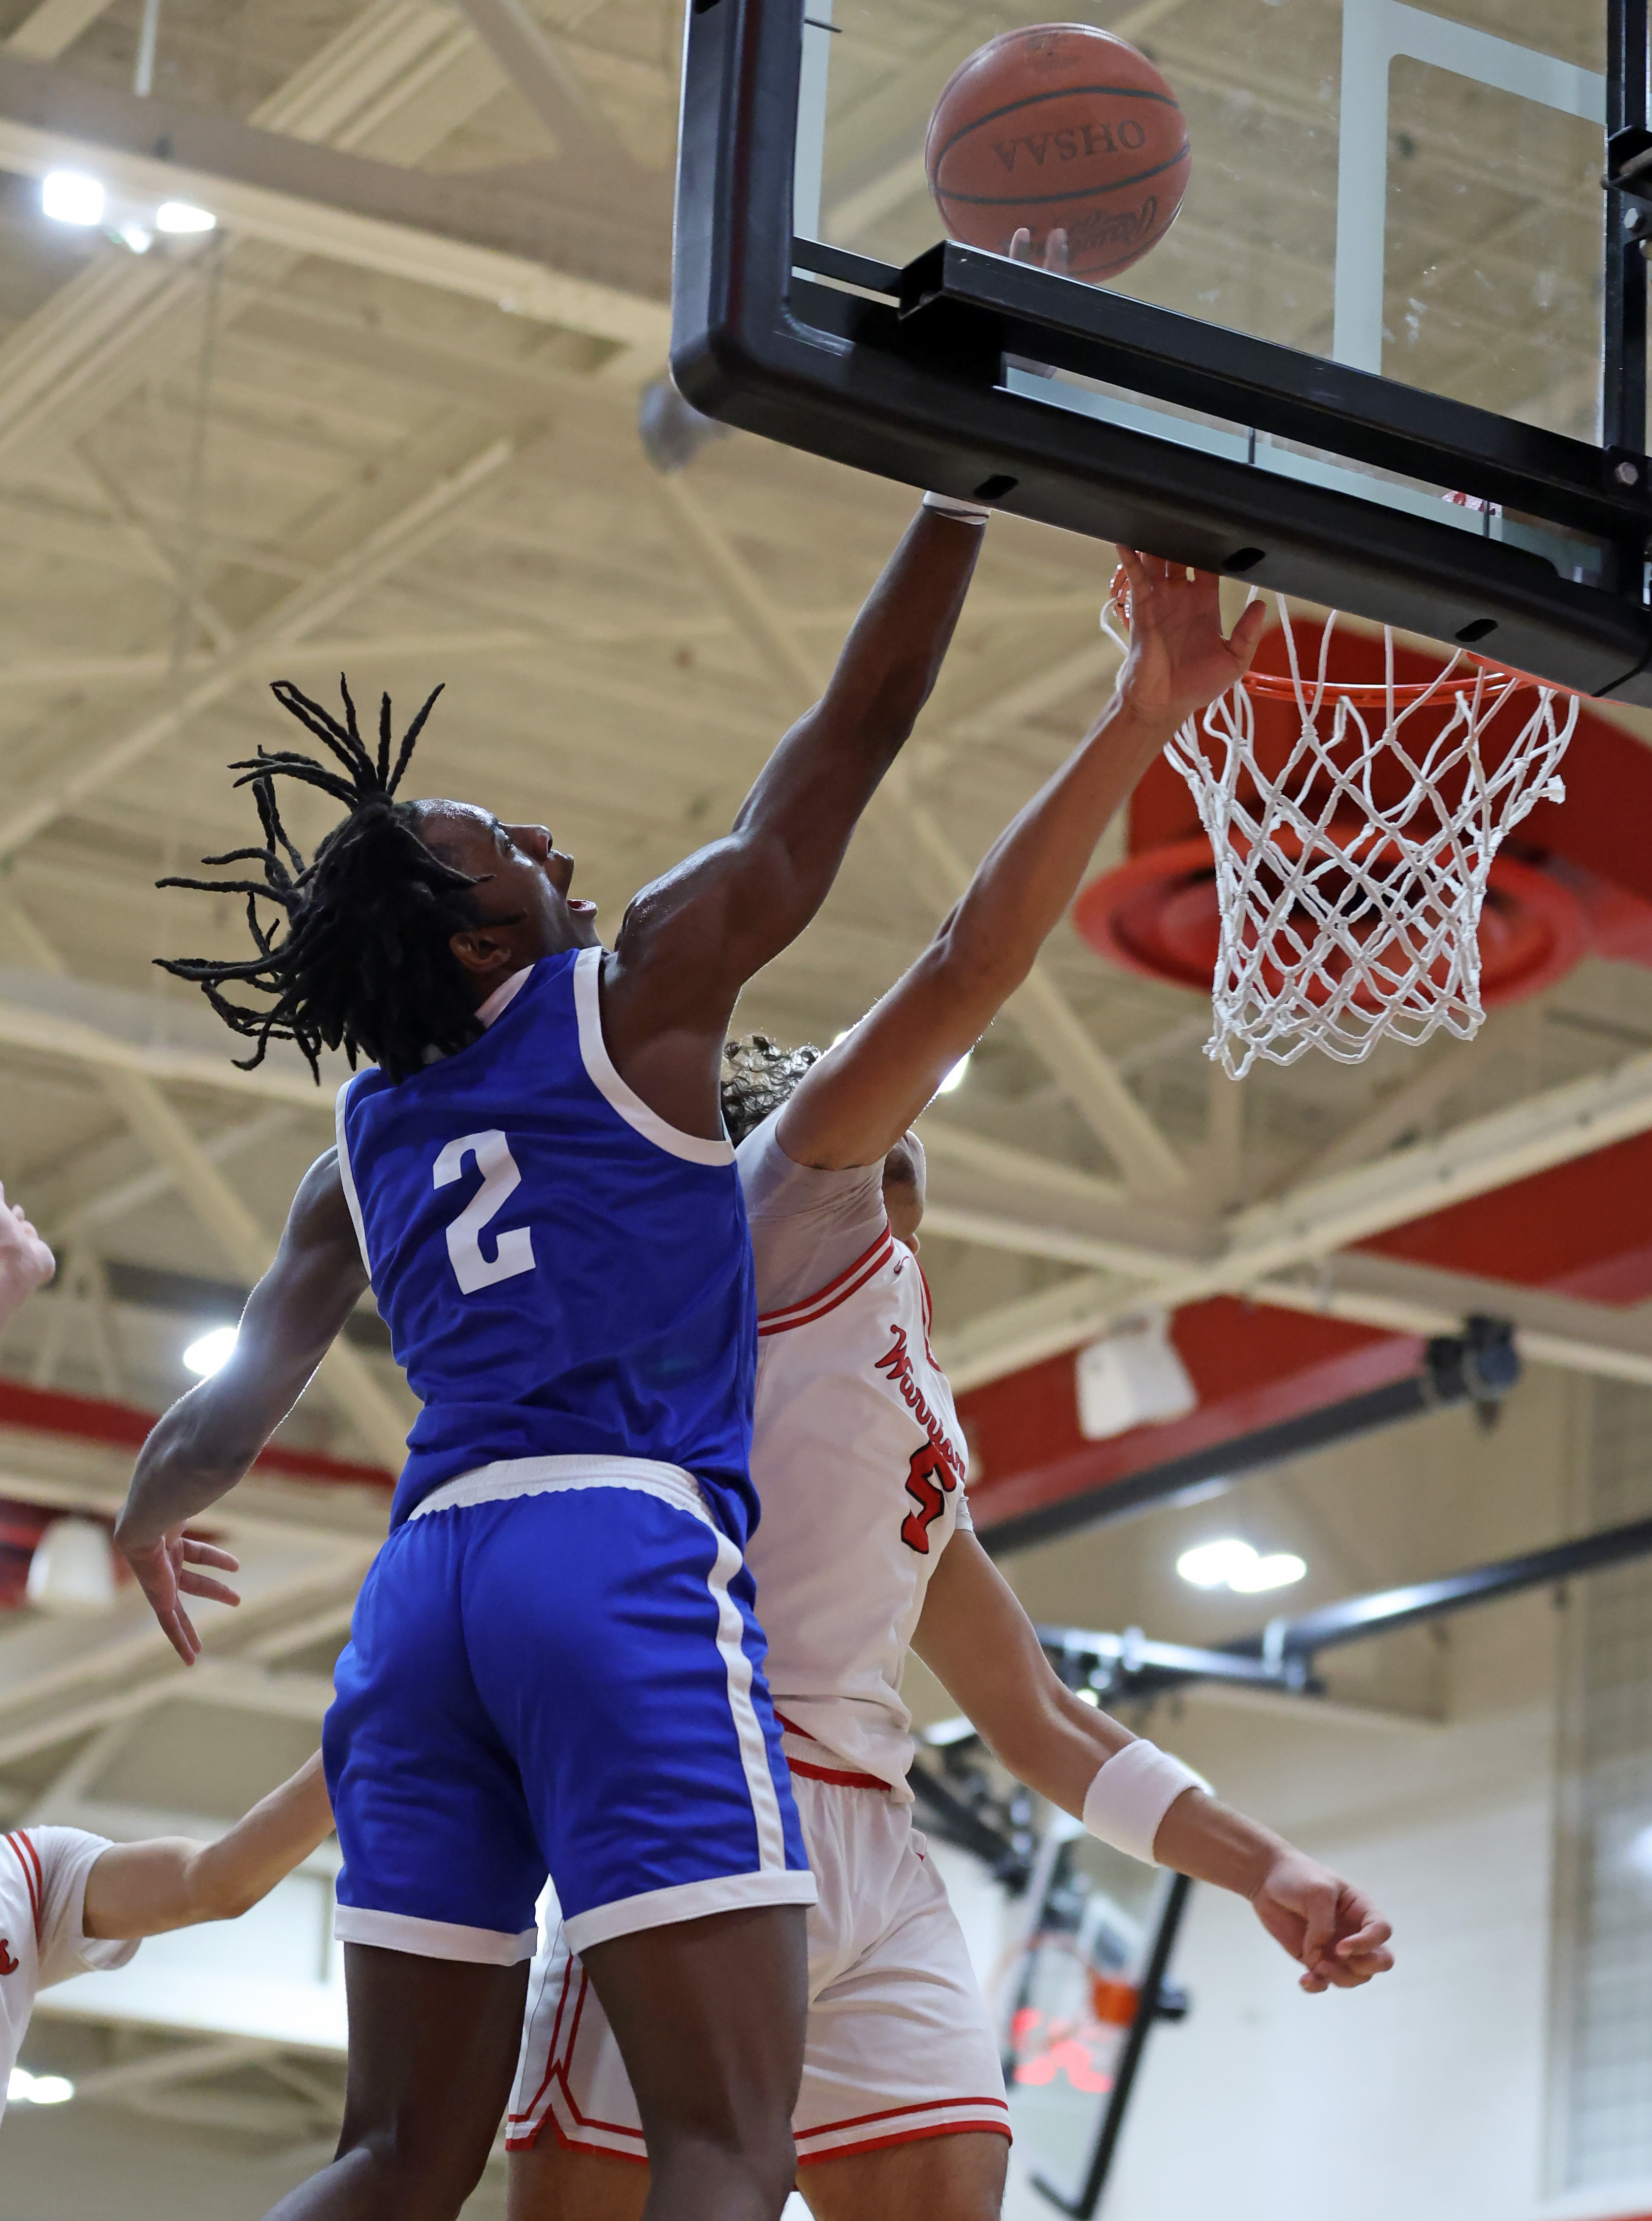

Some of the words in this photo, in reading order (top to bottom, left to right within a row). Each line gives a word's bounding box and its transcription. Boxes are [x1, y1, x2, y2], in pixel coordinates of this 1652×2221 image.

[993, 120, 1146, 172] OHSAA
[433, 1129, 536, 1295] 2
[902, 1440, 957, 1554] 5
